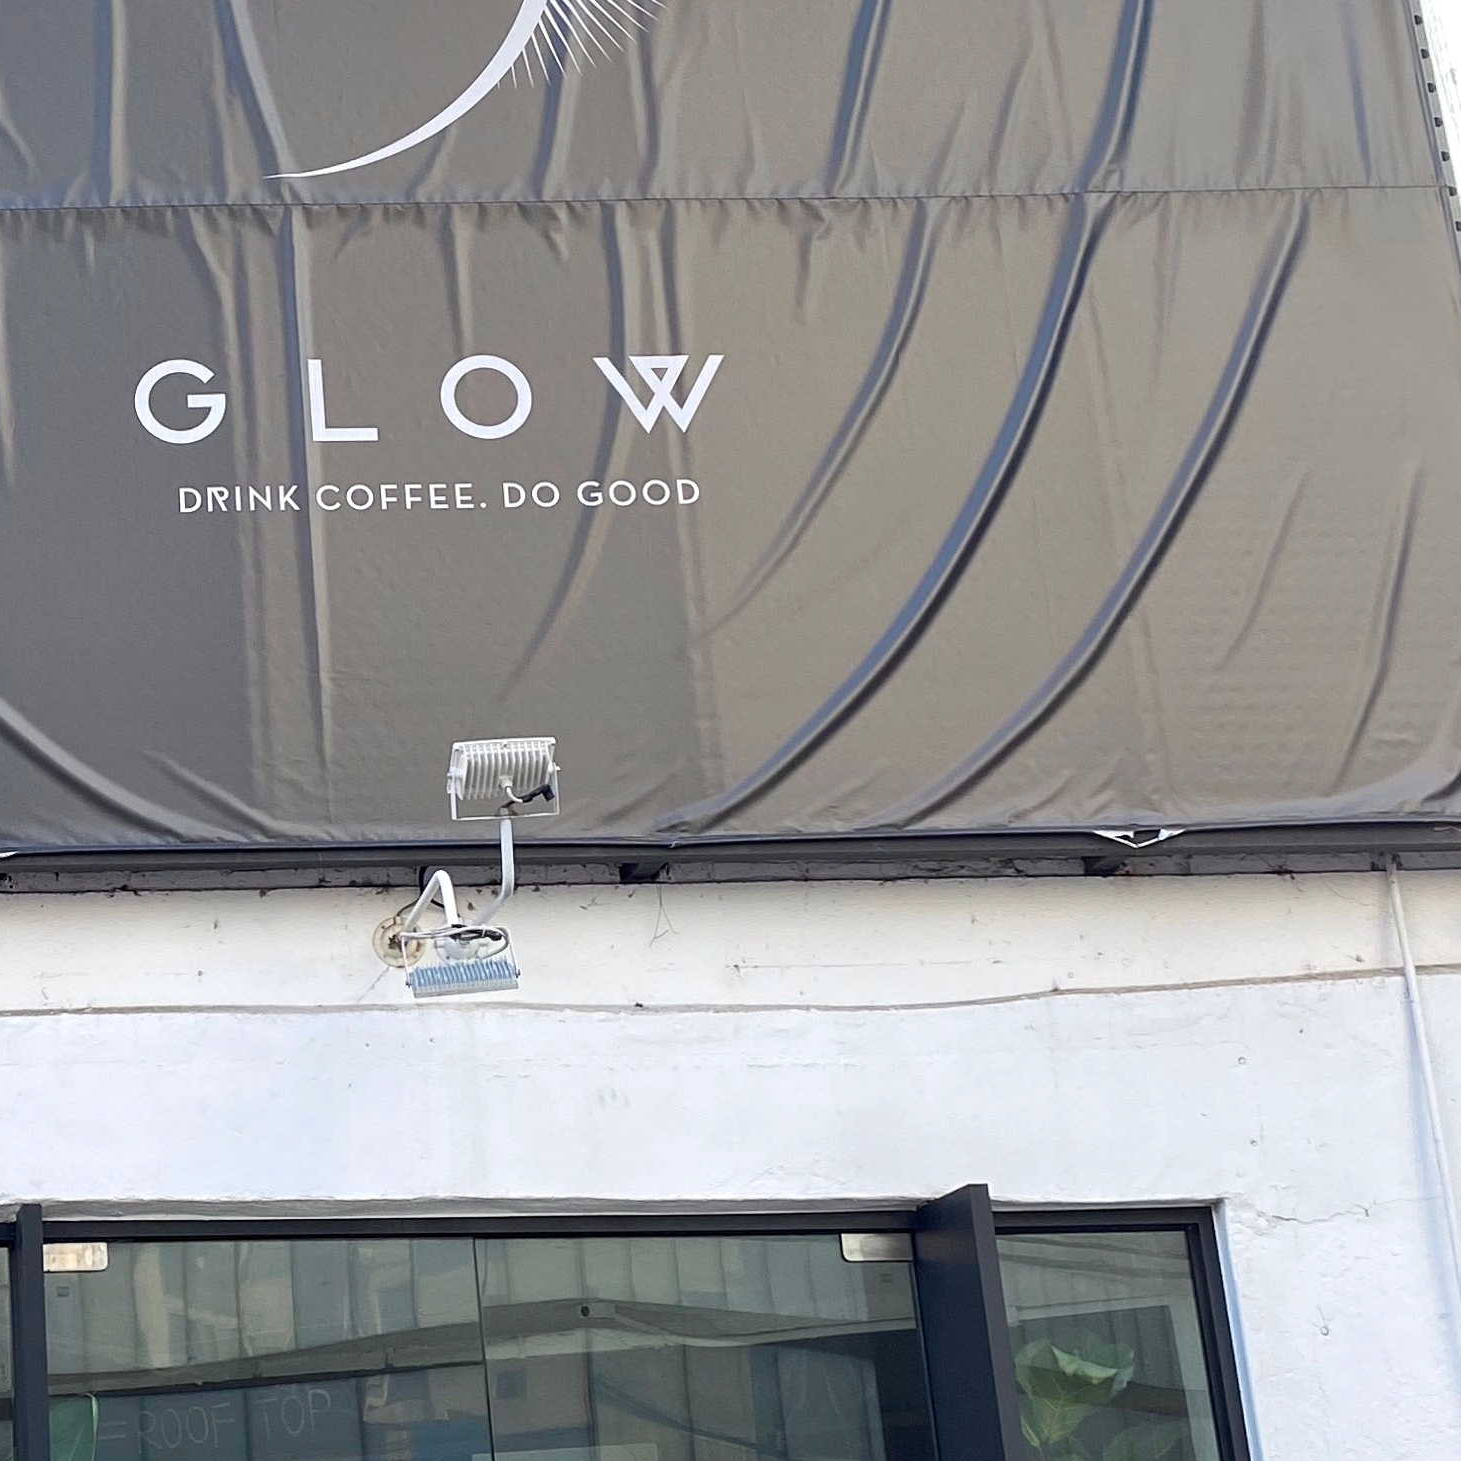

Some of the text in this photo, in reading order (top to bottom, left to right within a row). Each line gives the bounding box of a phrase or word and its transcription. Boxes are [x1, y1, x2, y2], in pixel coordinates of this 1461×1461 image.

[134, 353, 724, 444] GLOW
[178, 477, 701, 513] DRINK COFFEE. DO GOOD
[135, 1388, 333, 1454] ROOF TOP
